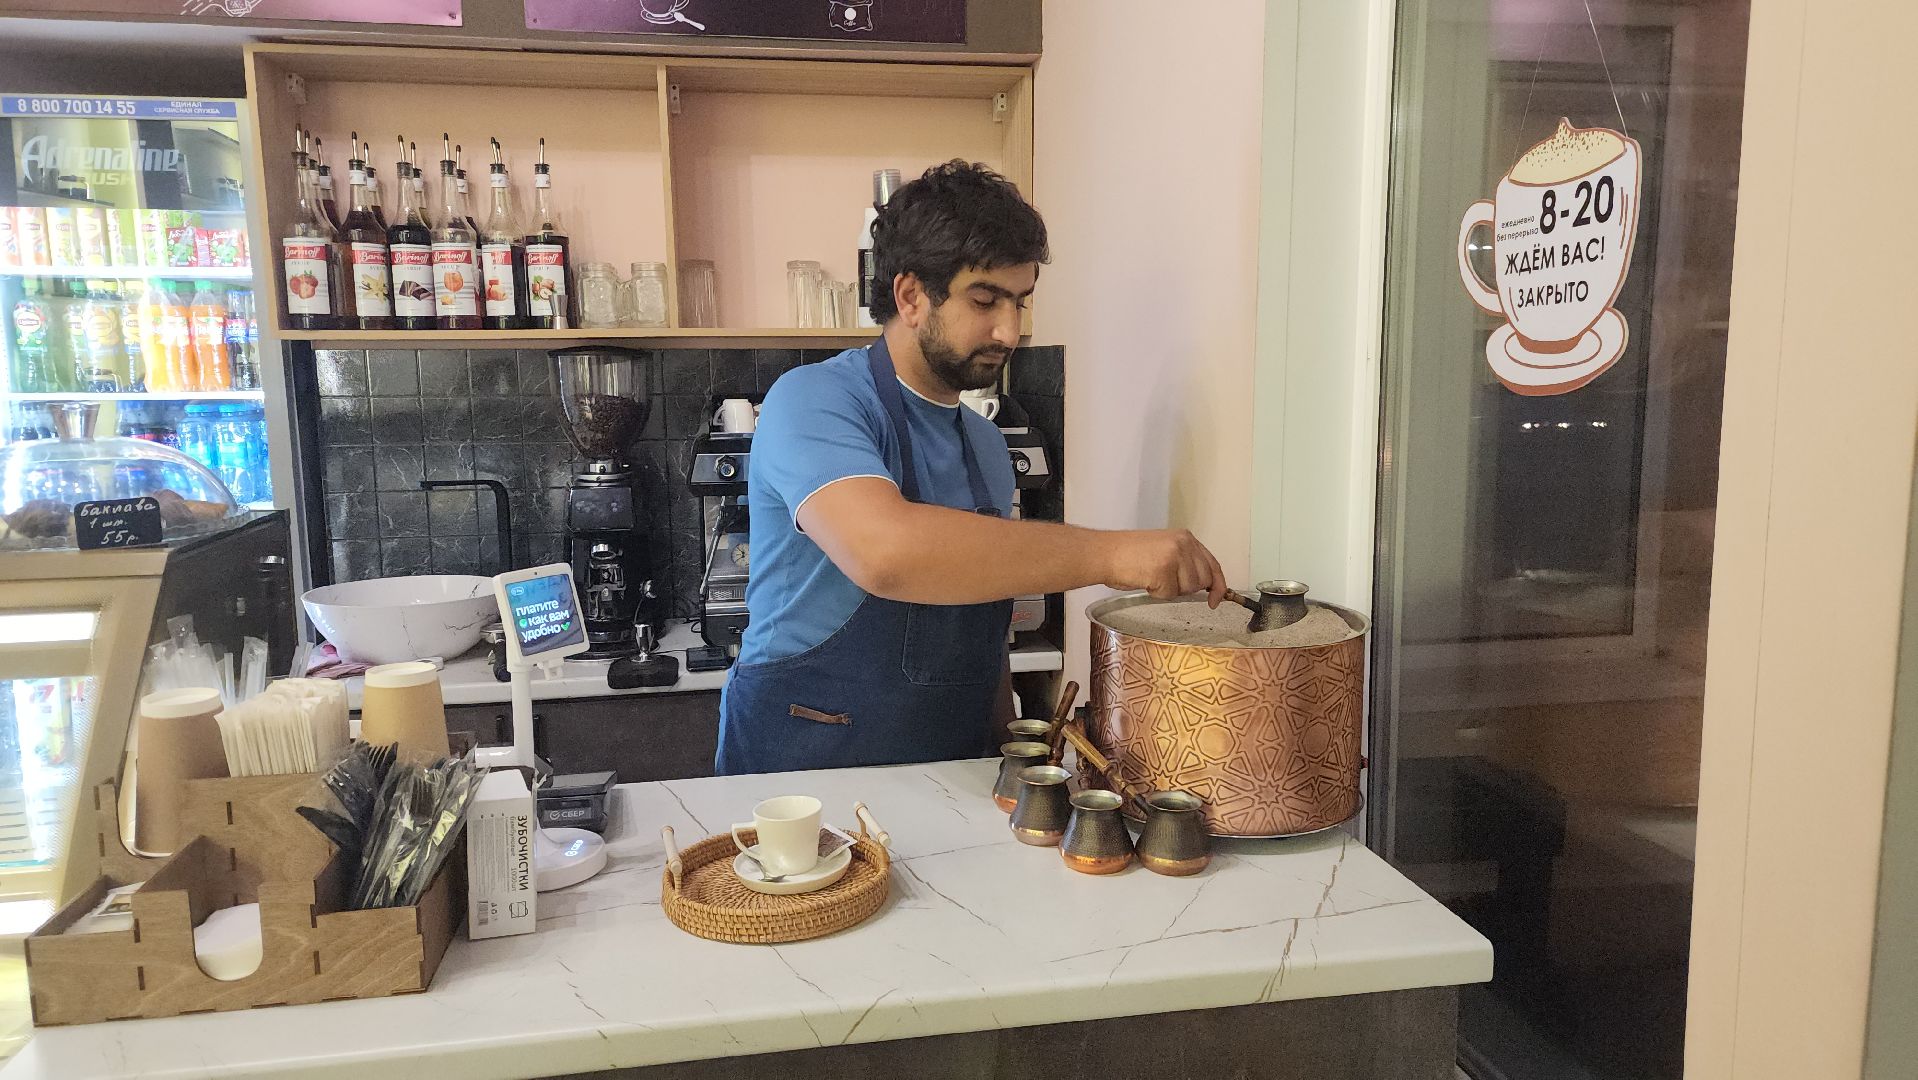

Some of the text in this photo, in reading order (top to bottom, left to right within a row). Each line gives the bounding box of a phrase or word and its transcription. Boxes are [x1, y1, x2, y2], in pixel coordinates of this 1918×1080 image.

[17, 99, 136, 115] 8 800 700 14 55
[21, 134, 180, 184] Adrenaline
[1538, 175, 1615, 235] 8-20
[1501, 215, 1535, 229] ежедневно
[1496, 227, 1539, 243] без перерыва
[285, 246, 321, 259] Barinoff
[361, 251, 387, 263] Barin
[394, 252, 430, 264] Barinoff
[433, 250, 468, 263] Barinoff
[528, 253, 559, 265] Barinoff
[1504, 235, 1606, 276] ЖДЁМ ВАС!
[1516, 280, 1589, 309] ЗАКРЫТО
[80, 498, 157, 517] Баклава
[89, 517, 98, 529] 1
[515, 599, 559, 617] платите
[528, 609, 570, 627] как вам
[520, 623, 562, 643] удобно
[561, 810, 585, 818] СБЕР
[517, 815, 529, 891] ЗУБОЧИСТКИ
